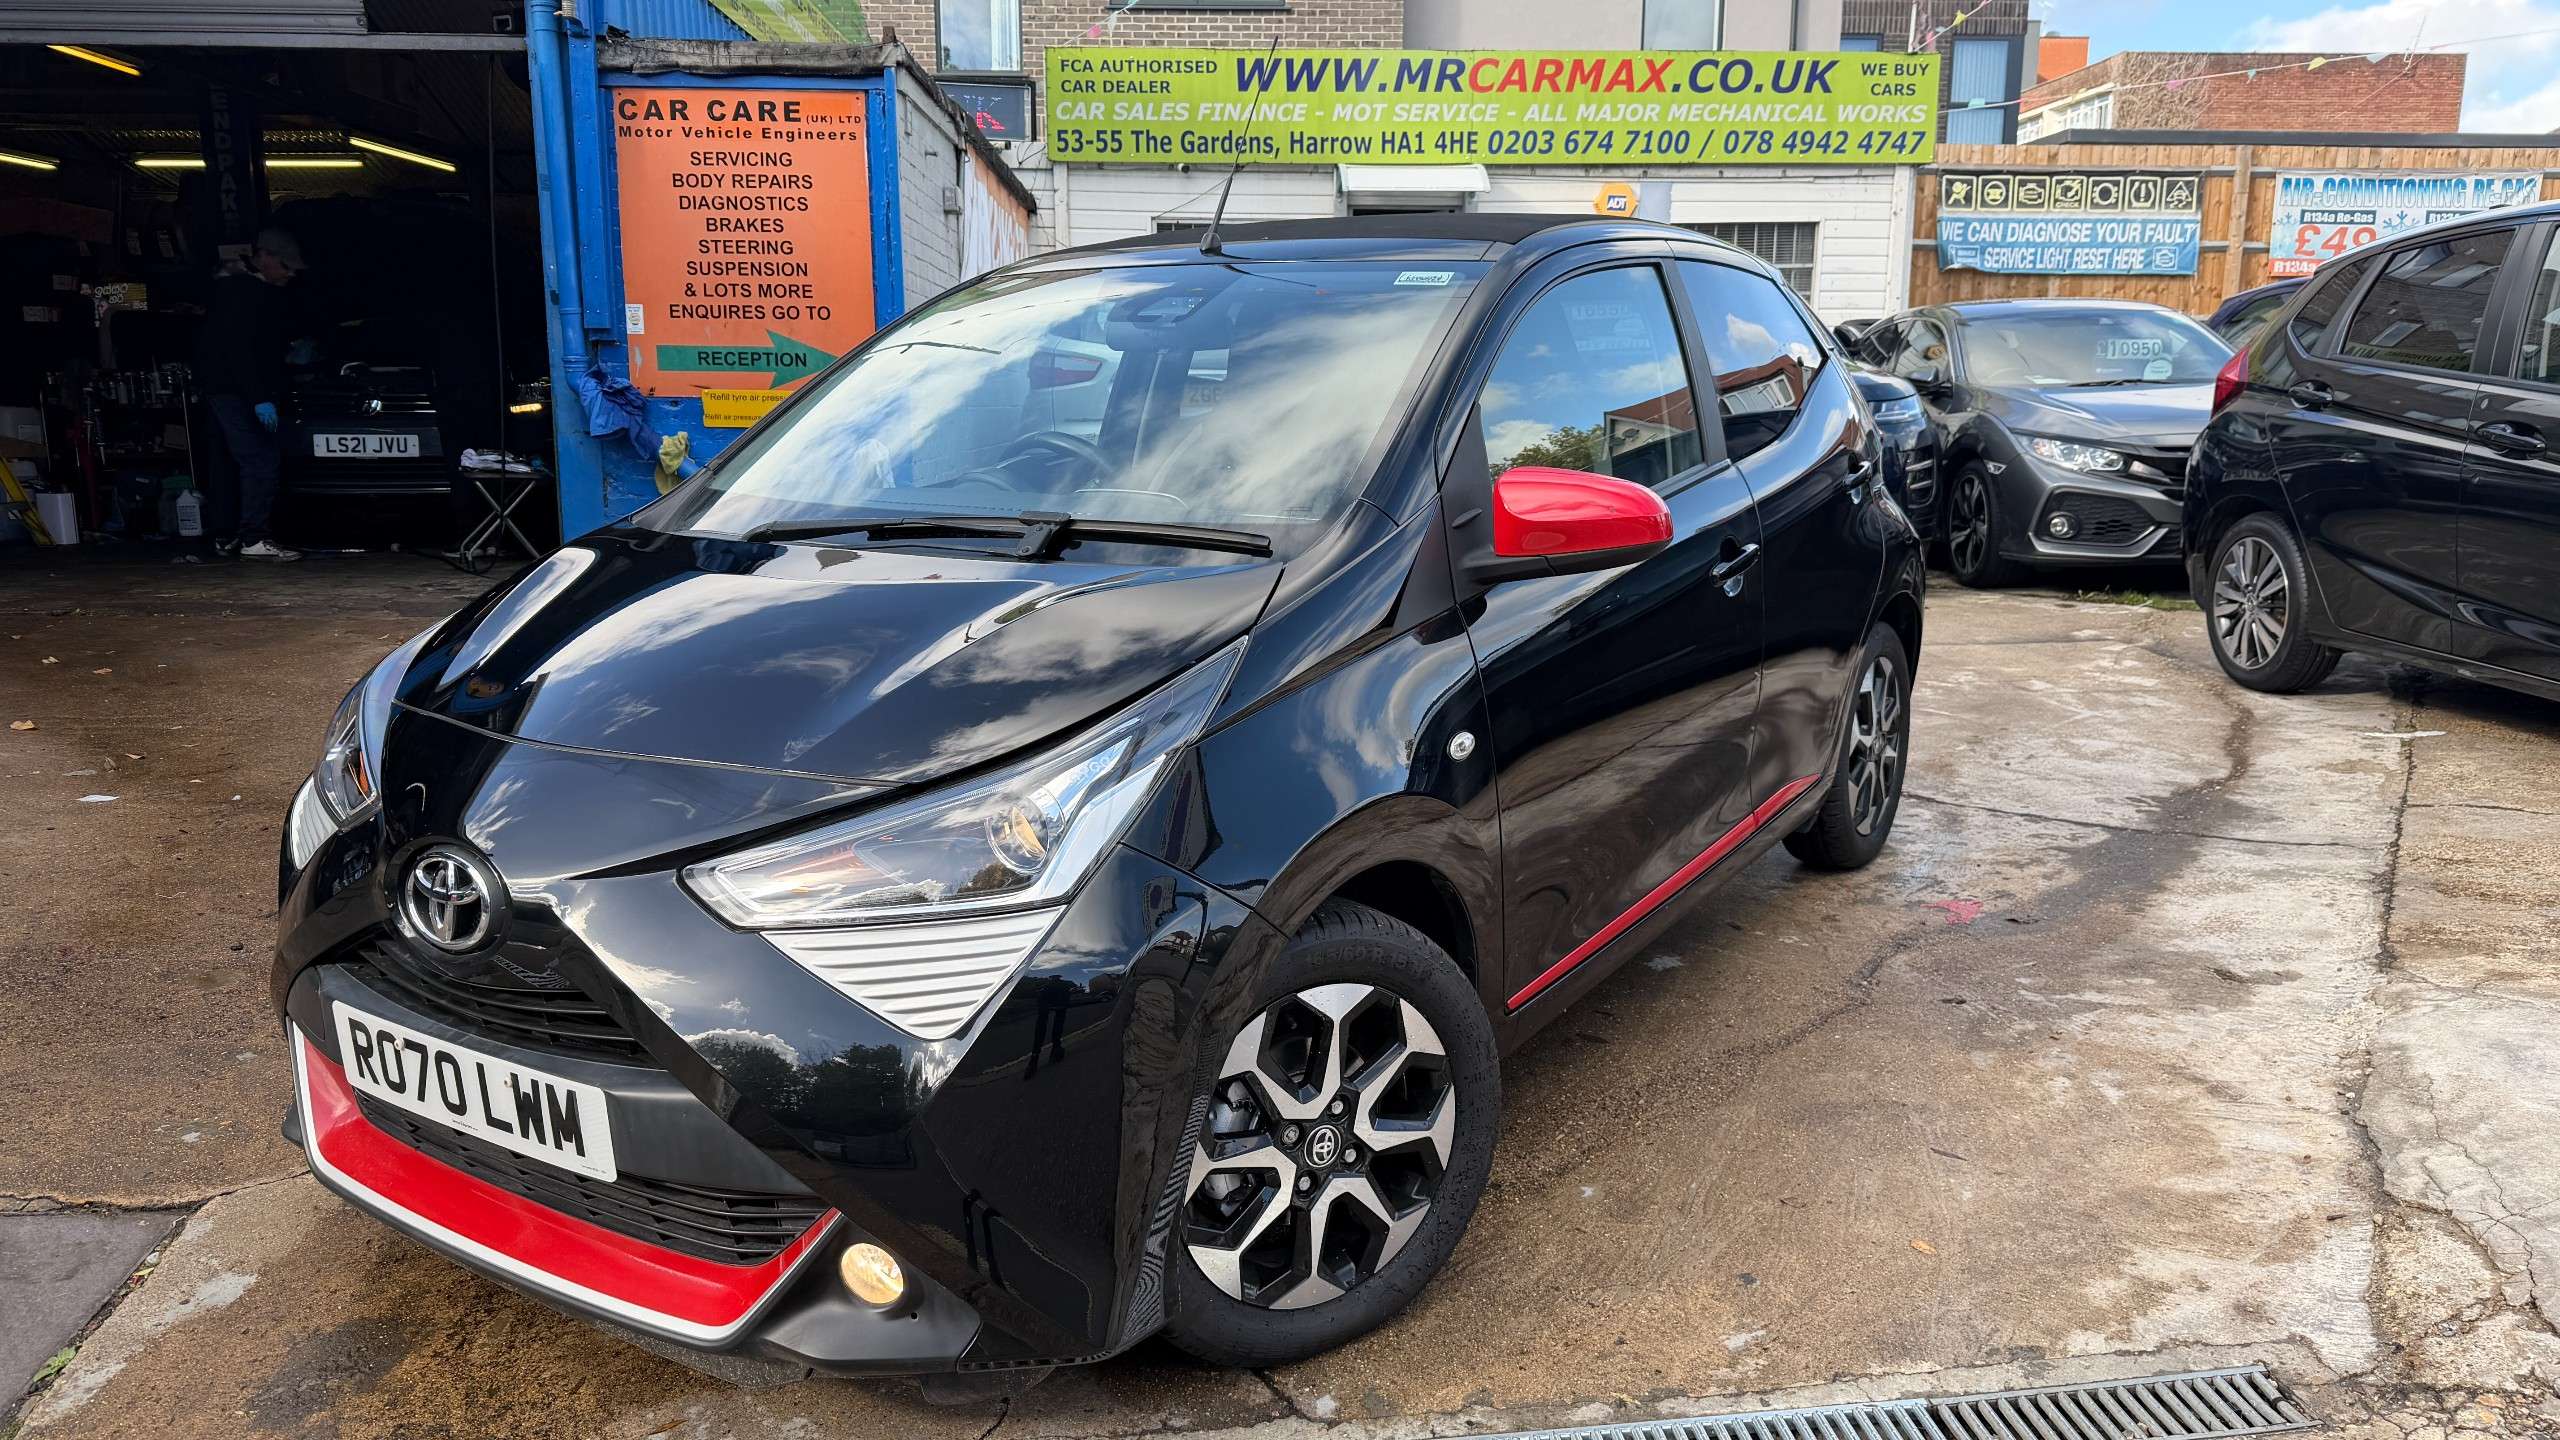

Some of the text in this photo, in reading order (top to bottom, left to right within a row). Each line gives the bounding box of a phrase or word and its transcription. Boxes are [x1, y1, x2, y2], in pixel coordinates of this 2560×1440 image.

[1061, 59, 1218, 74] FCA AUTHORISED
[1861, 63, 1930, 76] WE BUY
[1237, 57, 1840, 94] WWW.MRCARMAX.CO.UK
[1061, 79, 1171, 94] CAR DEALER
[1870, 83, 1916, 96] CARS
[619, 99, 862, 125] CAR CARE (UK) LTD
[1056, 101, 1105, 121] CAR
[1113, 101, 1190, 121] SALES
[1197, 102, 1307, 122] FINANCE
[1332, 103, 1387, 122] MOT
[1392, 103, 1499, 122] SERVICE
[1523, 103, 1568, 122] ALL
[1576, 103, 1661, 123] MAJOR
[1667, 103, 1827, 123] MECHANICAL
[1838, 104, 1928, 123] WORKS
[619, 125, 858, 143] Motor Vehicle Engineers
[1056, 129, 1123, 154] 53-55
[1131, 129, 1173, 154] The
[1180, 130, 1280, 159] Gardens,
[1290, 131, 1373, 155] Harrow
[1381, 131, 1425, 154] HA1
[1434, 131, 1478, 155] 4HE
[1487, 130, 1555, 155] 0203
[1564, 130, 1614, 155] 674
[1623, 130, 1690, 155] 7100
[1723, 130, 1775, 155] 078
[1782, 130, 1849, 155] 4942
[1857, 130, 1927, 155] 4747
[690, 151, 793, 168] SERVICING
[672, 173, 813, 190] BODY REPAIRS
[2279, 177, 2468, 208] AIR-CONDITIONING
[679, 195, 809, 212] DIAGNOSTICS
[1607, 197, 1626, 209] ADT
[706, 218, 785, 234] BRAKES
[2337, 212, 2374, 223] Re-Gas
[1941, 222, 2195, 243] WE CAN DIAGNOSE YOUR FAULT
[698, 240, 794, 256] STEERING
[1984, 247, 2145, 270] SERVICE LIGHT RESET HERE
[686, 261, 809, 277] SUSPENSION
[684, 283, 813, 299] & LOTS MORE
[669, 304, 831, 321] ENQUIRES GO TO
[698, 351, 807, 368] RECEPTION
[710, 392, 730, 401] Refill
[732, 393, 747, 403] tyre
[749, 393, 760, 402] air
[325, 437, 408, 454] LS21 JVU
[348, 1016, 586, 1159] RO70 LWM
